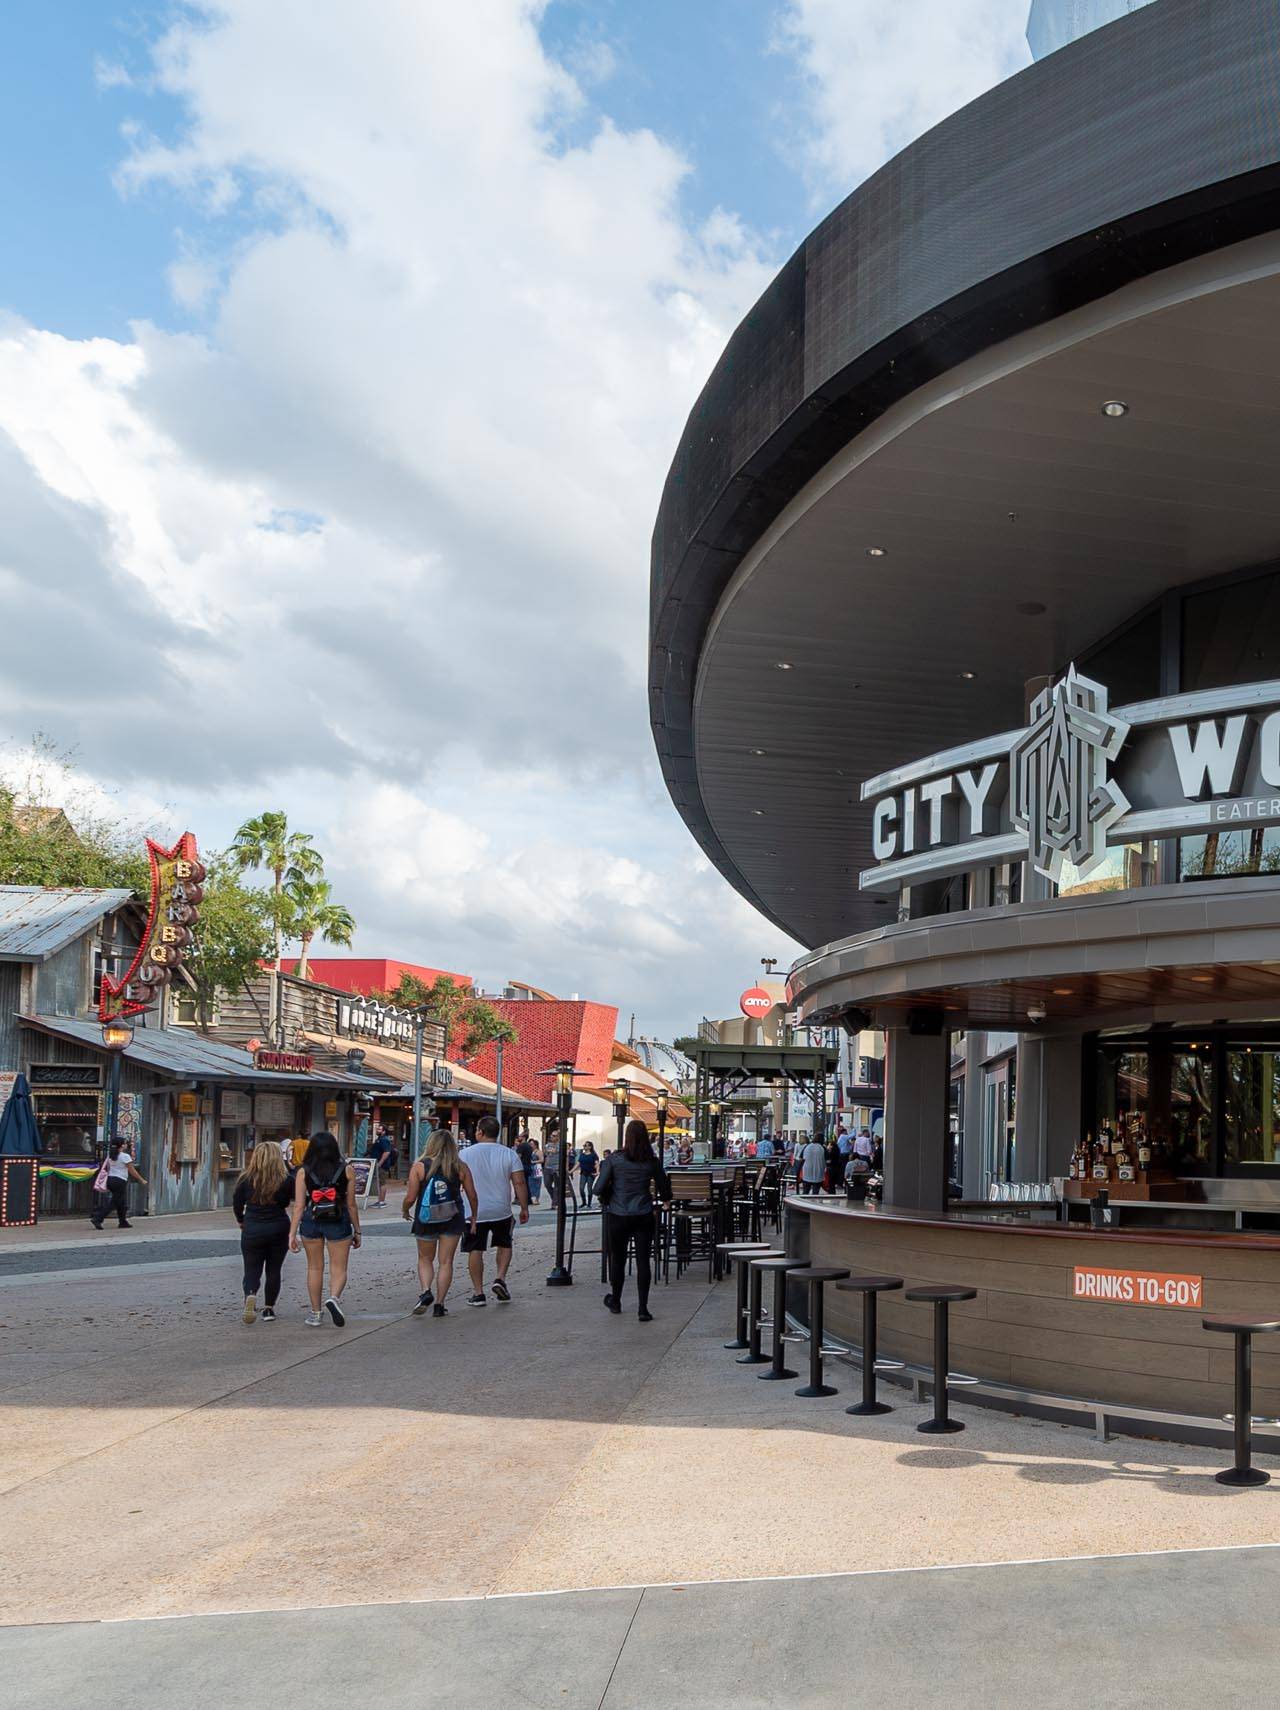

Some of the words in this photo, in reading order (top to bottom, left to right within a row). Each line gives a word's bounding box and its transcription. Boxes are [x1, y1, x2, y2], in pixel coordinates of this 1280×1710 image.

[873, 762, 999, 860] CITY
[261, 1052, 314, 1071] SMOKEHOUS
[1075, 1272, 1134, 1300] DRINKS
[1137, 1277, 1190, 1304] TO-GO
